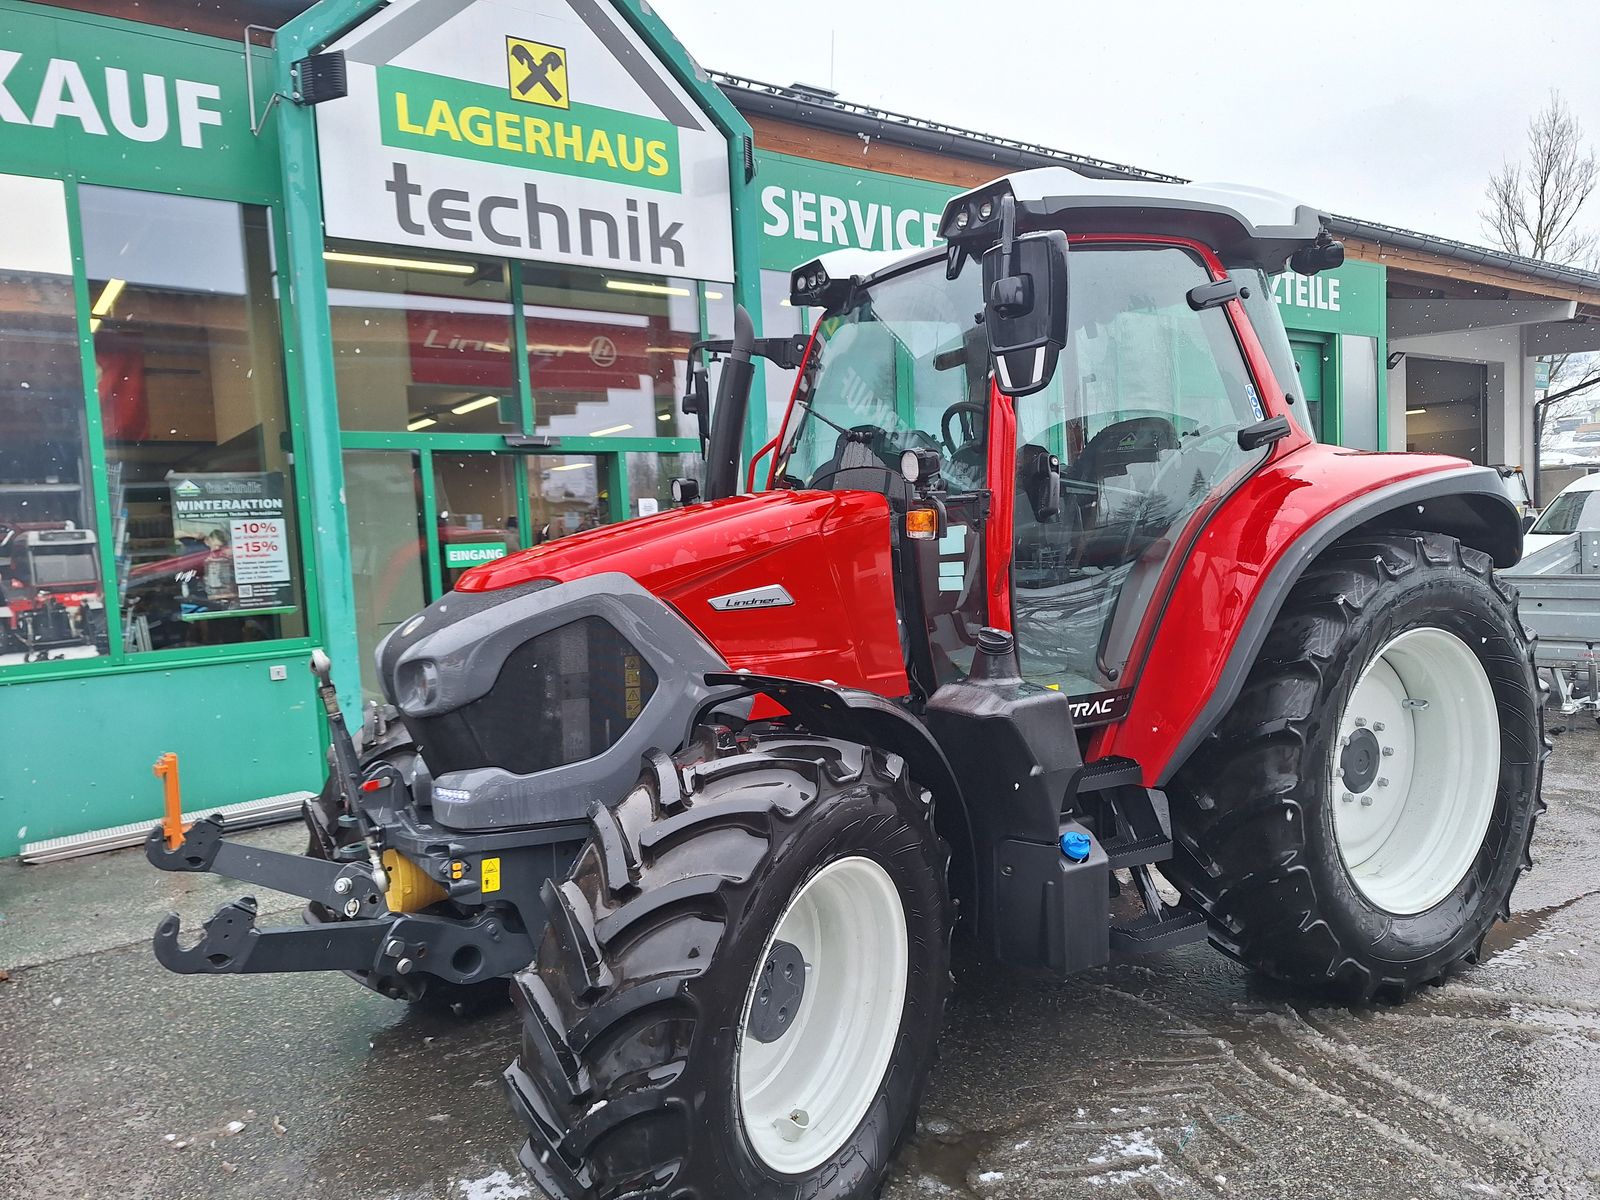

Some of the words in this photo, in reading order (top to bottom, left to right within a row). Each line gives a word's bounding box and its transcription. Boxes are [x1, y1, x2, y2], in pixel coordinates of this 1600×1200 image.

[0, 50, 223, 149] KAUF
[395, 92, 670, 176] LAGERHAUS
[385, 162, 685, 267] technik
[761, 185, 945, 251] SERVICE
[176, 498, 283, 512] WINTERAKTION
[234, 522, 277, 534] -10%
[236, 541, 278, 552] -15%
[449, 548, 504, 562] EINGANG
[725, 597, 780, 608] Lindner
[1068, 697, 1116, 718] TRAC
